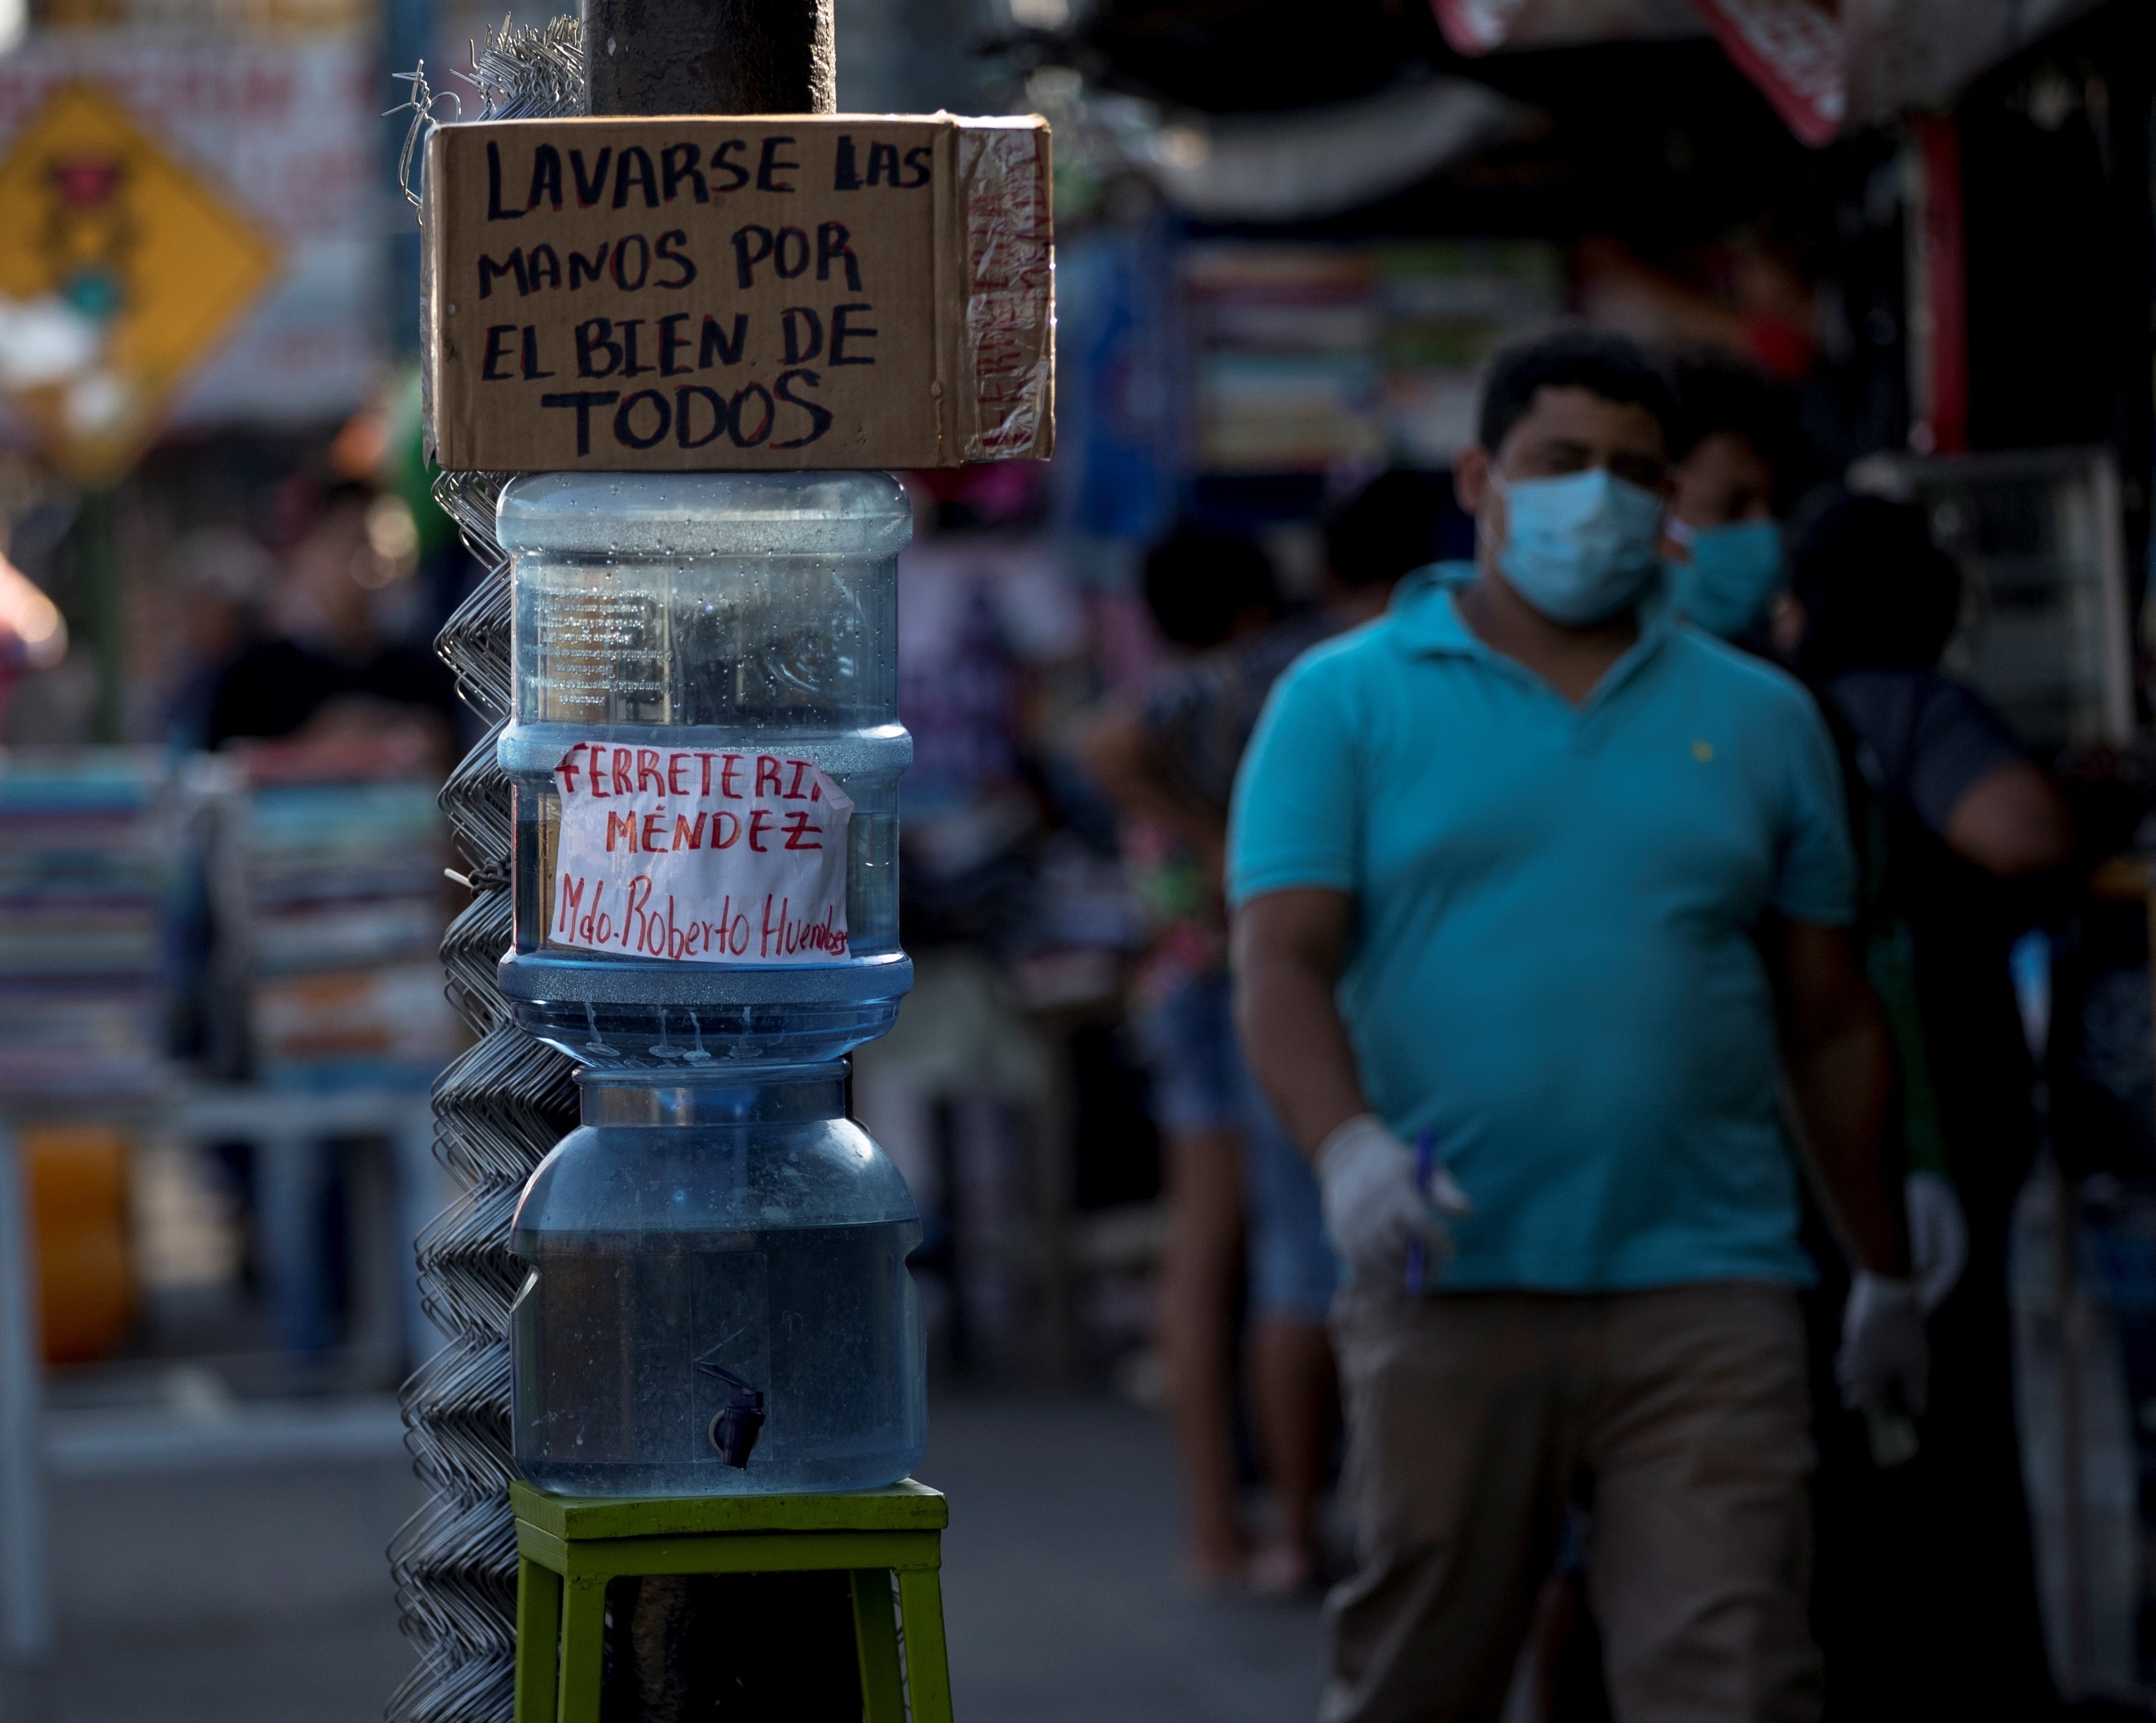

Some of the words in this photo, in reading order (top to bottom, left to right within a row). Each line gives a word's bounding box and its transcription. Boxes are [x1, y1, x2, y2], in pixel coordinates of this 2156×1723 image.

[487, 136, 800, 221] LAVARSE
[833, 135, 932, 192] LAS
[477, 230, 697, 300] MANOS
[731, 222, 862, 292] POR
[482, 324, 555, 381] EL
[574, 312, 749, 379] BIEN
[781, 302, 878, 366] DE
[541, 369, 833, 458] TODOS
[606, 804, 823, 853] MÉNDEZ
[559, 873, 619, 945] Mdo.
[621, 875, 750, 961] Roberto
